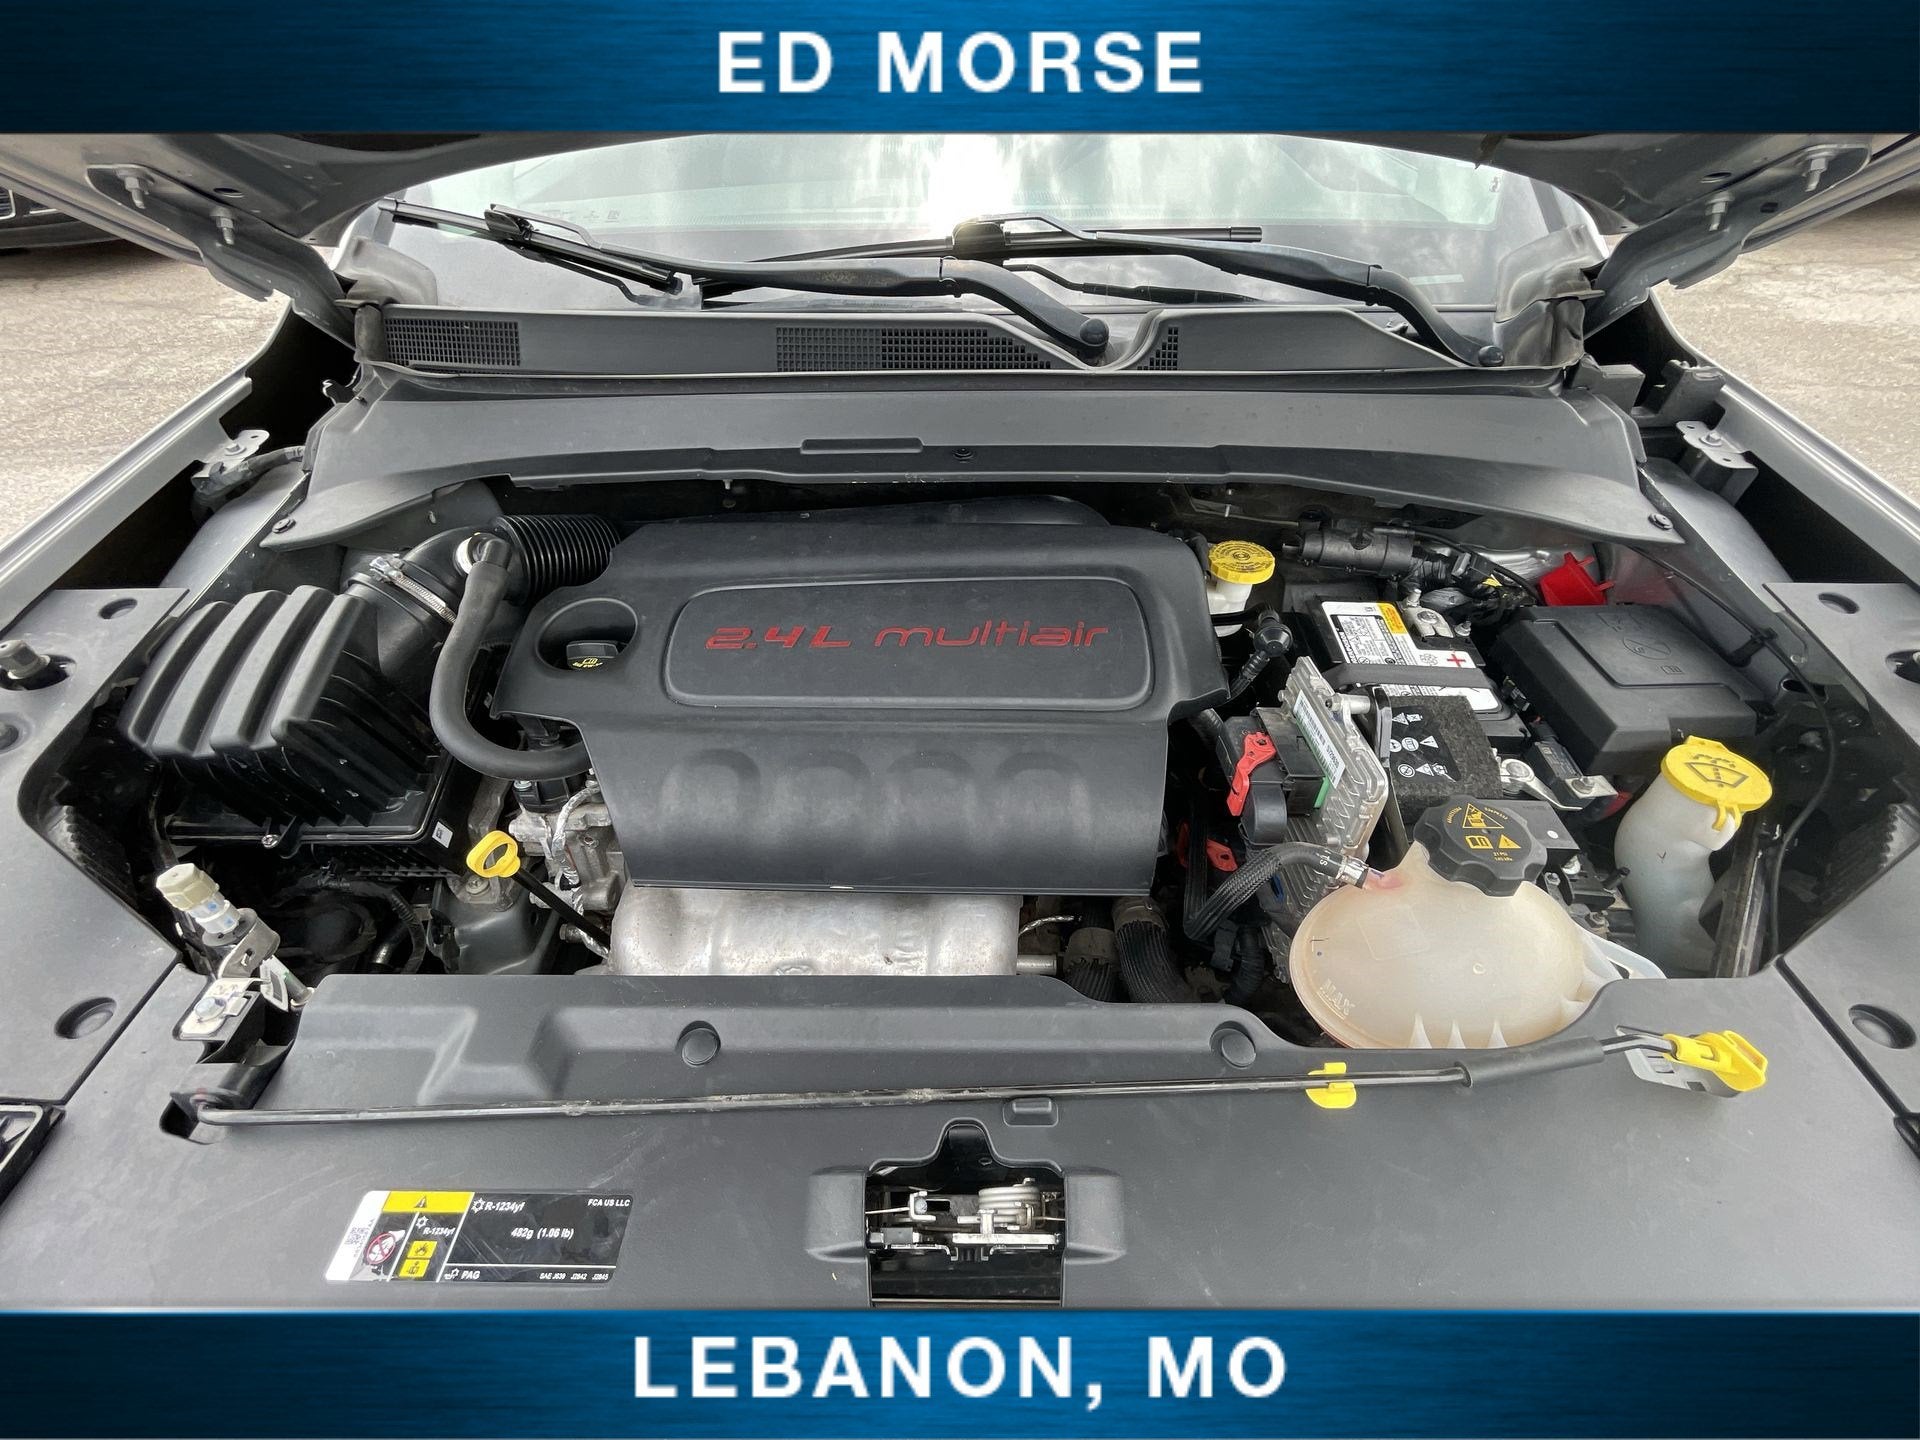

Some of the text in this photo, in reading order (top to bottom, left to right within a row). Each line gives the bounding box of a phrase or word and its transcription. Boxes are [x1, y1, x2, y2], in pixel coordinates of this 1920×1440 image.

[705, 620, 1109, 650] 2.4L multiair
[484, 1201, 525, 1213] R-1234yf
[587, 1198, 631, 1207] FCA US LLC
[510, 1227, 575, 1240] 482g (1.06 lb)
[460, 1269, 481, 1280] PAG
